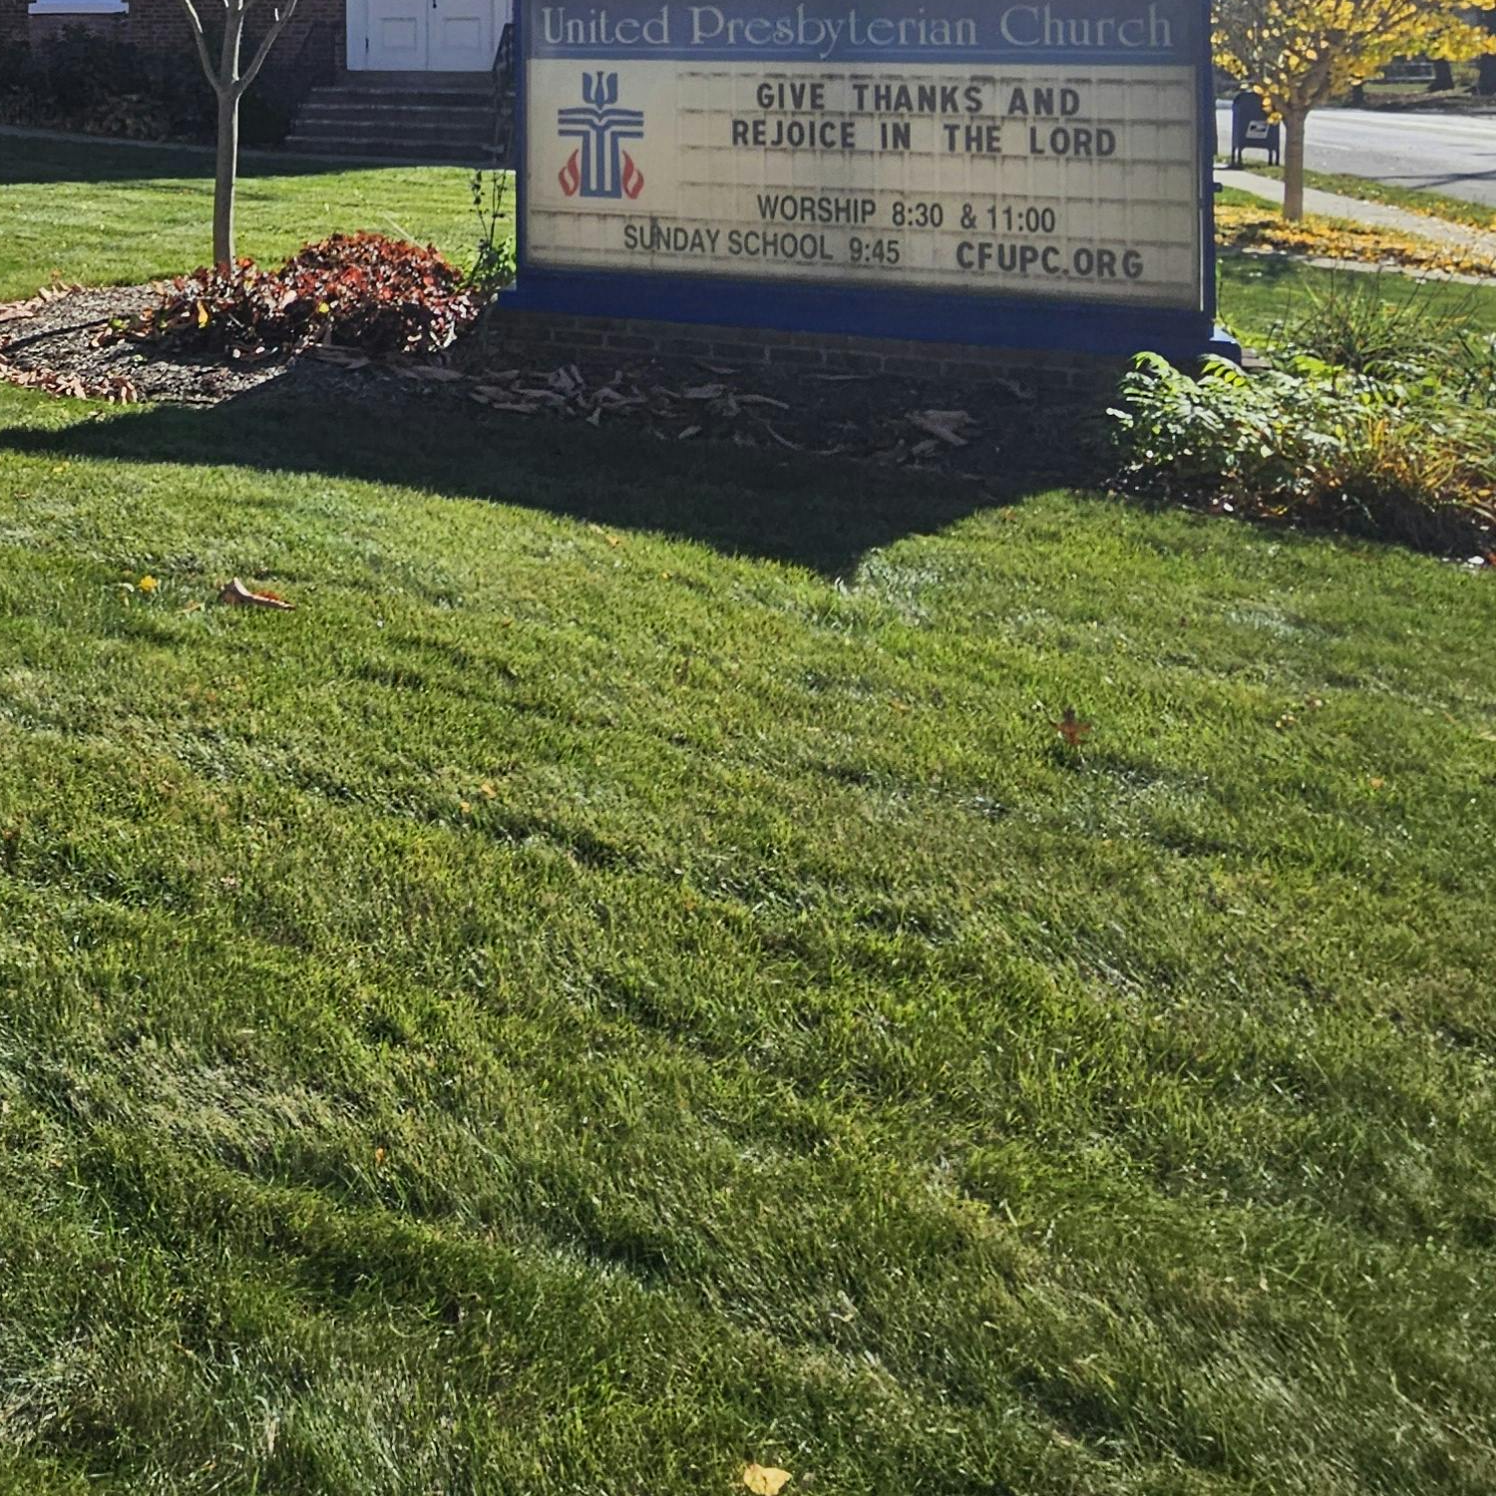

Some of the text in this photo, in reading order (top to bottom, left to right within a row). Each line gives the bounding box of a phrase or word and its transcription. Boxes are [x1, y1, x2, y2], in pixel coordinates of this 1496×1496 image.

[541, 3, 1174, 60] United Presbyterian Church
[756, 82, 1081, 116] GIVE THANKS AND
[732, 119, 1117, 156] REJOICE IN THE LORD
[757, 194, 1056, 234] WORSHIP 8:30 & 11:00
[623, 224, 900, 265] SUNDAY SCHOOL 9:45
[956, 240, 1144, 279] CFUPC.ORG
